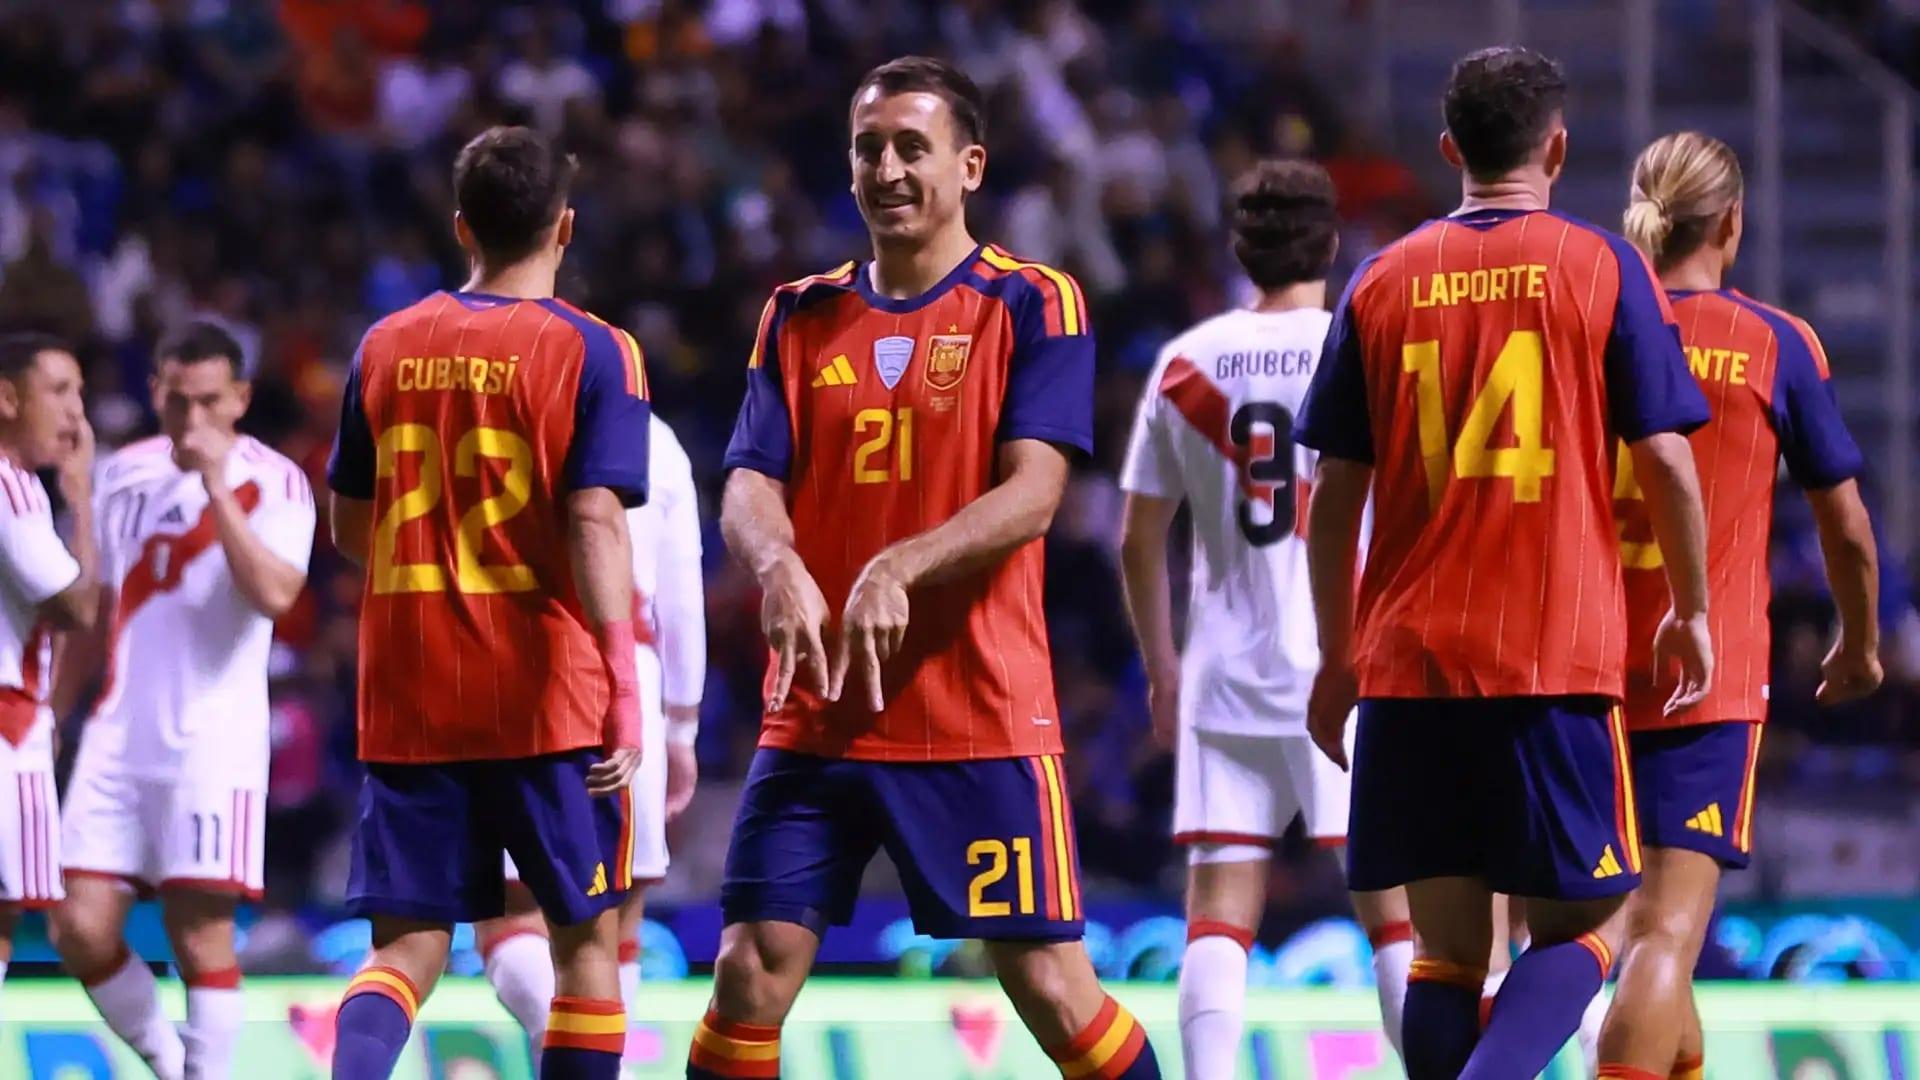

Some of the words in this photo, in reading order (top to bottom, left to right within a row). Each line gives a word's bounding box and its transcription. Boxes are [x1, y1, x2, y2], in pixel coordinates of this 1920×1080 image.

[1412, 264, 1547, 308] LAPORTE
[397, 355, 519, 395] CUBARSÍ
[1683, 346, 1750, 385] NTE
[854, 406, 912, 484] 21
[1402, 330, 1554, 510] 14
[373, 423, 539, 594] 22
[1230, 401, 1295, 547] 3
[191, 812, 221, 862] 11
[967, 837, 1034, 917] 21
